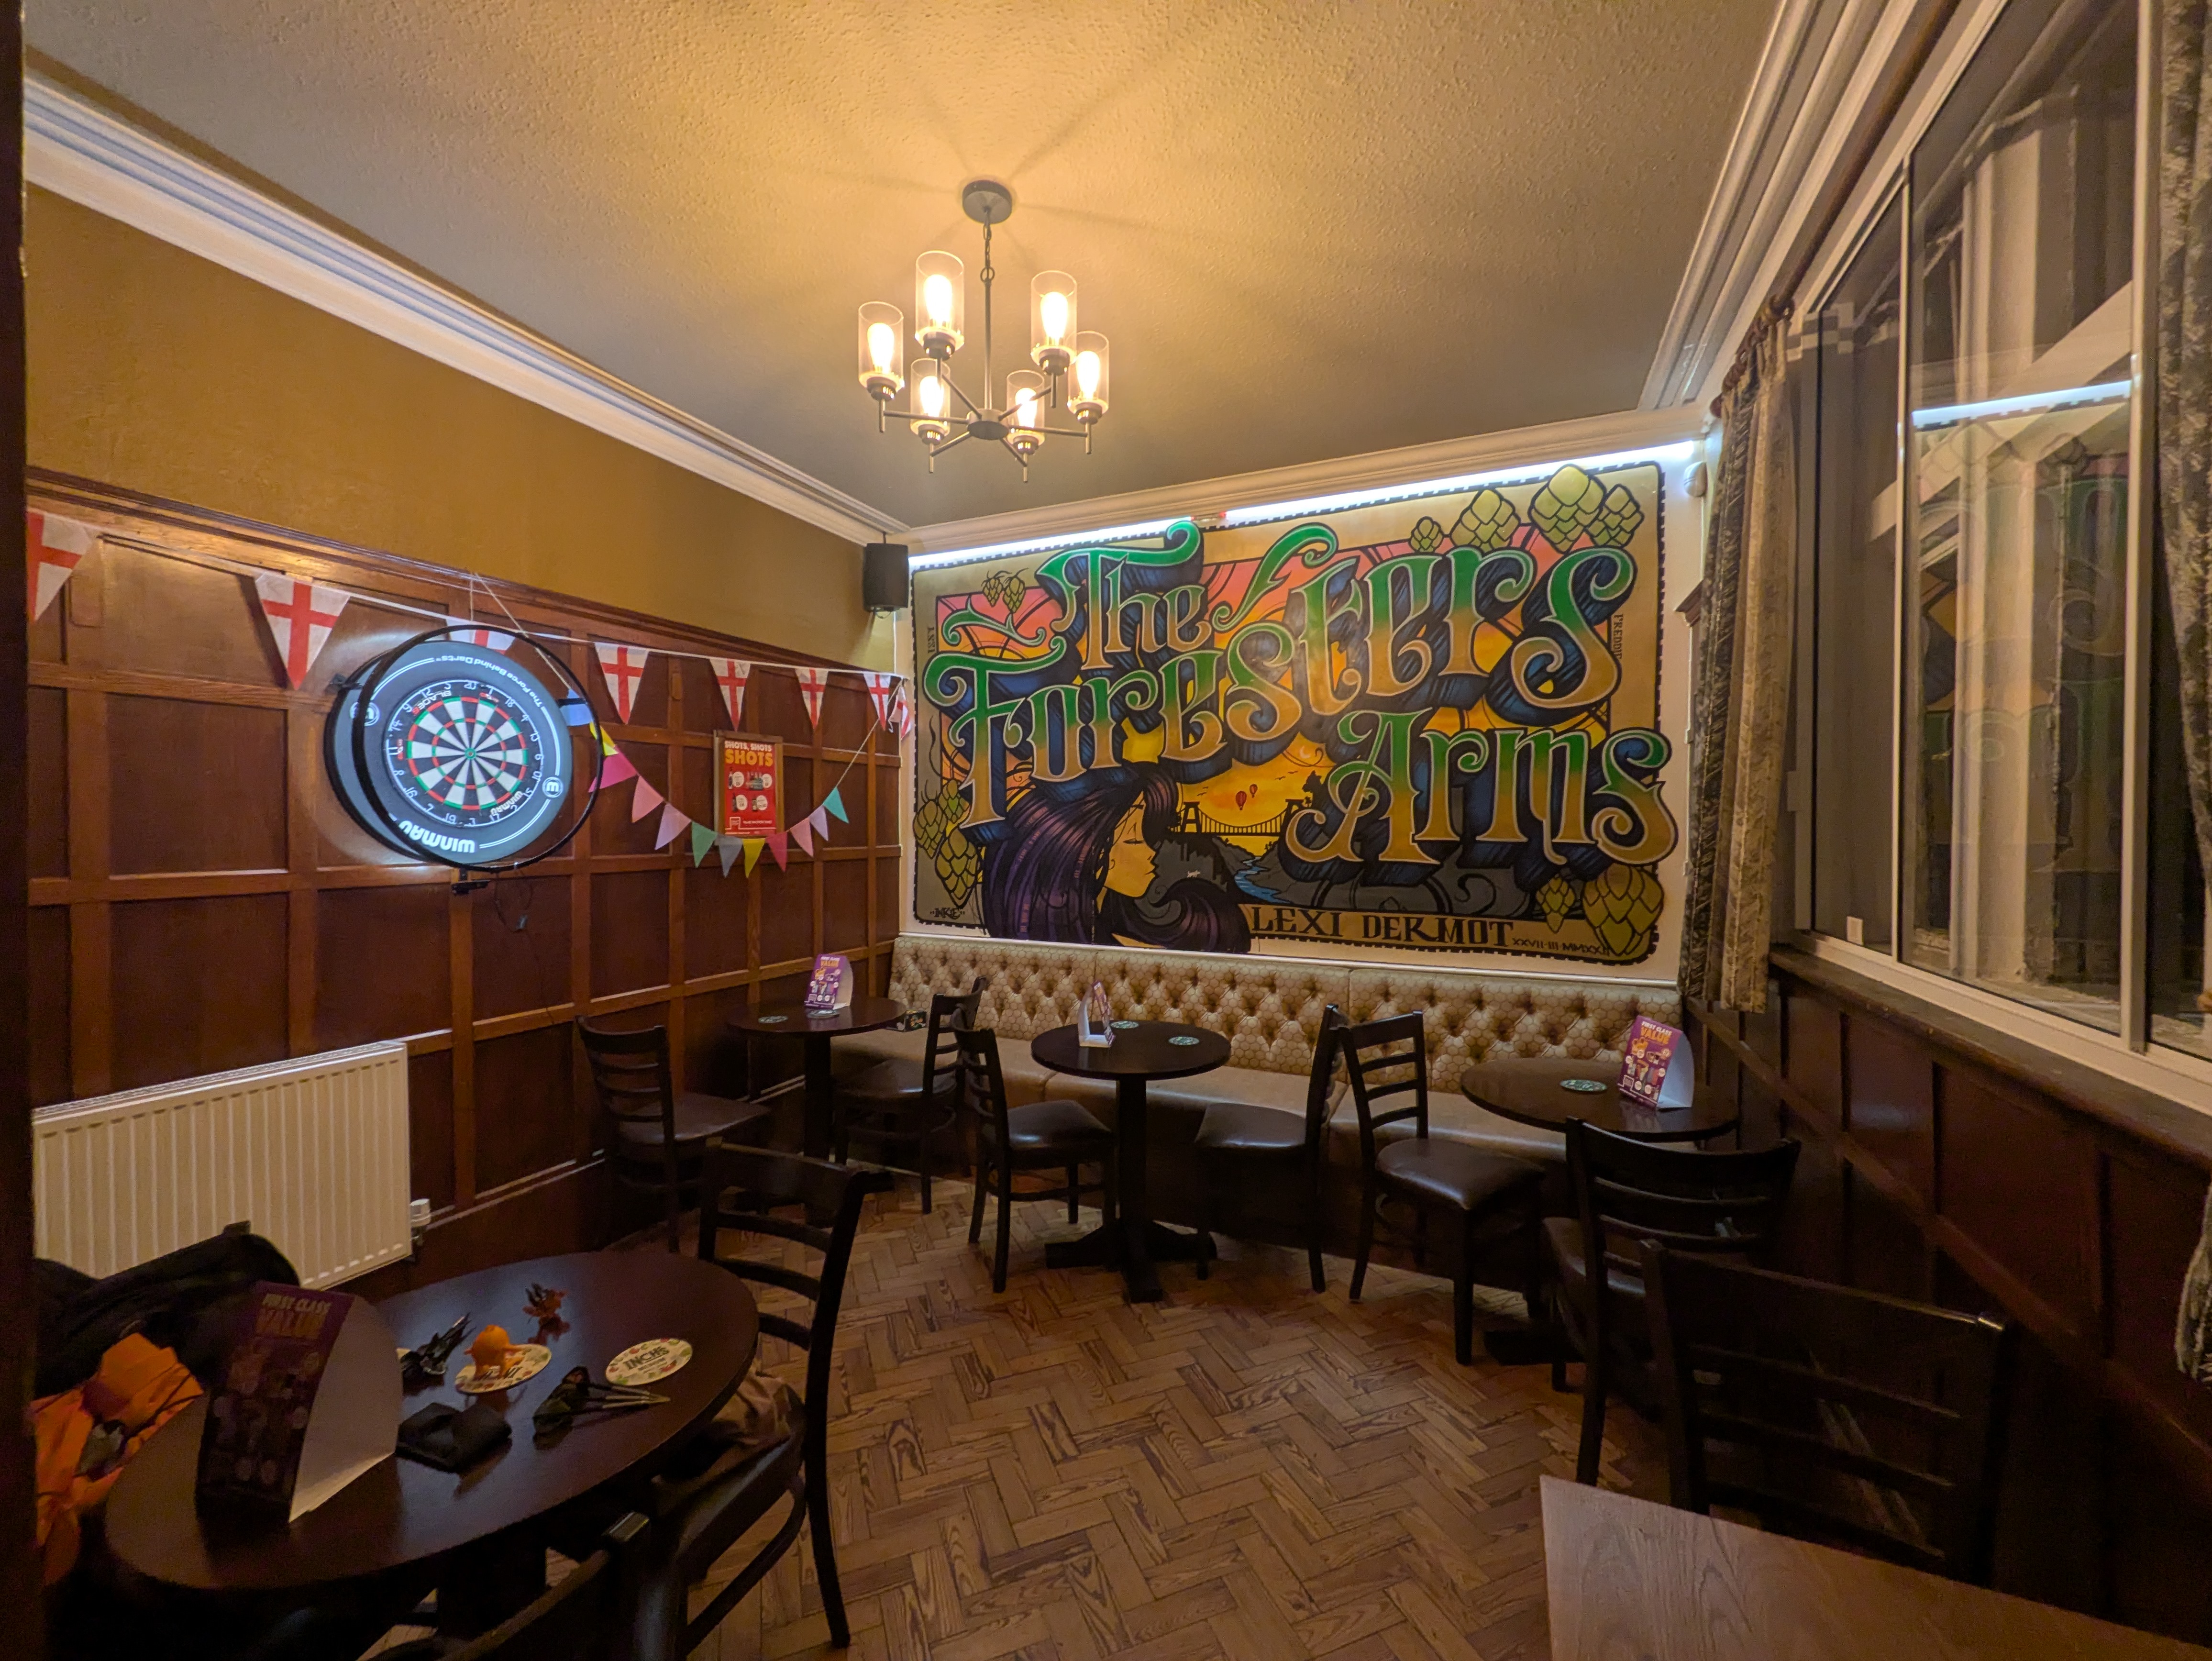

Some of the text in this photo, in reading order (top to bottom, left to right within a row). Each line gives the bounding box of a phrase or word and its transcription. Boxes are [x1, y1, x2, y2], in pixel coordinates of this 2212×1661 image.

[1036, 520, 1213, 670] The
[474, 658, 508, 676] Behind
[924, 523, 1634, 830] Foresters
[506, 673, 531, 693] Force
[529, 692, 542, 708] The
[725, 749, 773, 767] SHOTS
[1285, 707, 1679, 866] Arms
[1251, 907, 1343, 937] LEXI
[1362, 915, 1513, 946] DERMOT
